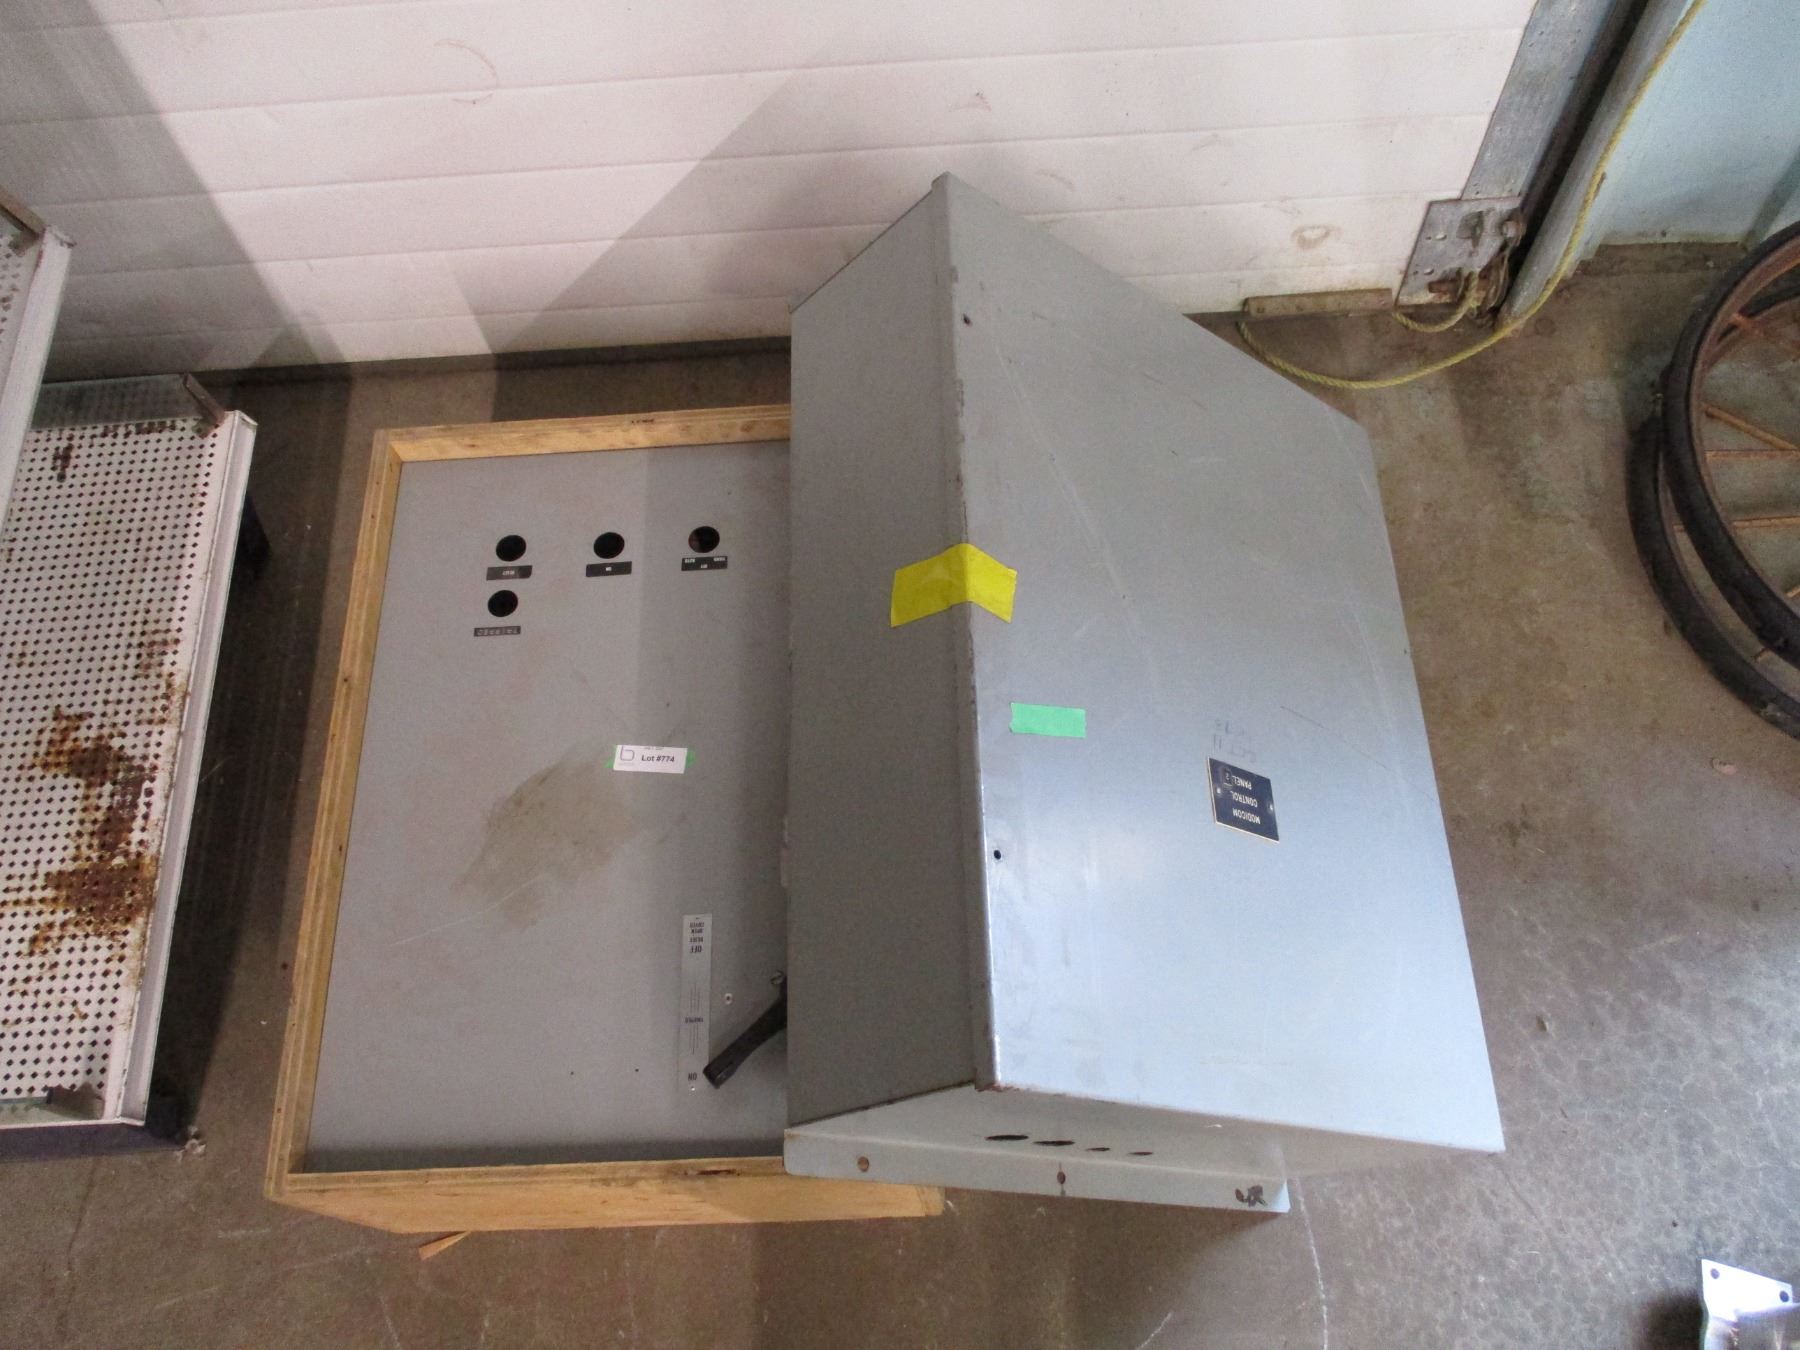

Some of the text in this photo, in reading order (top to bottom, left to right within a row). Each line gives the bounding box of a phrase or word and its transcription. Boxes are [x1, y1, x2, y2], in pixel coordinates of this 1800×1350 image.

[656, 755, 675, 763] #774
[1232, 775, 1252, 790] PANEL
[1230, 790, 1258, 808] CONTROL
[1232, 807, 1261, 825] MODICOM
[691, 945, 702, 953] OFF
[687, 1072, 698, 1081] ON
